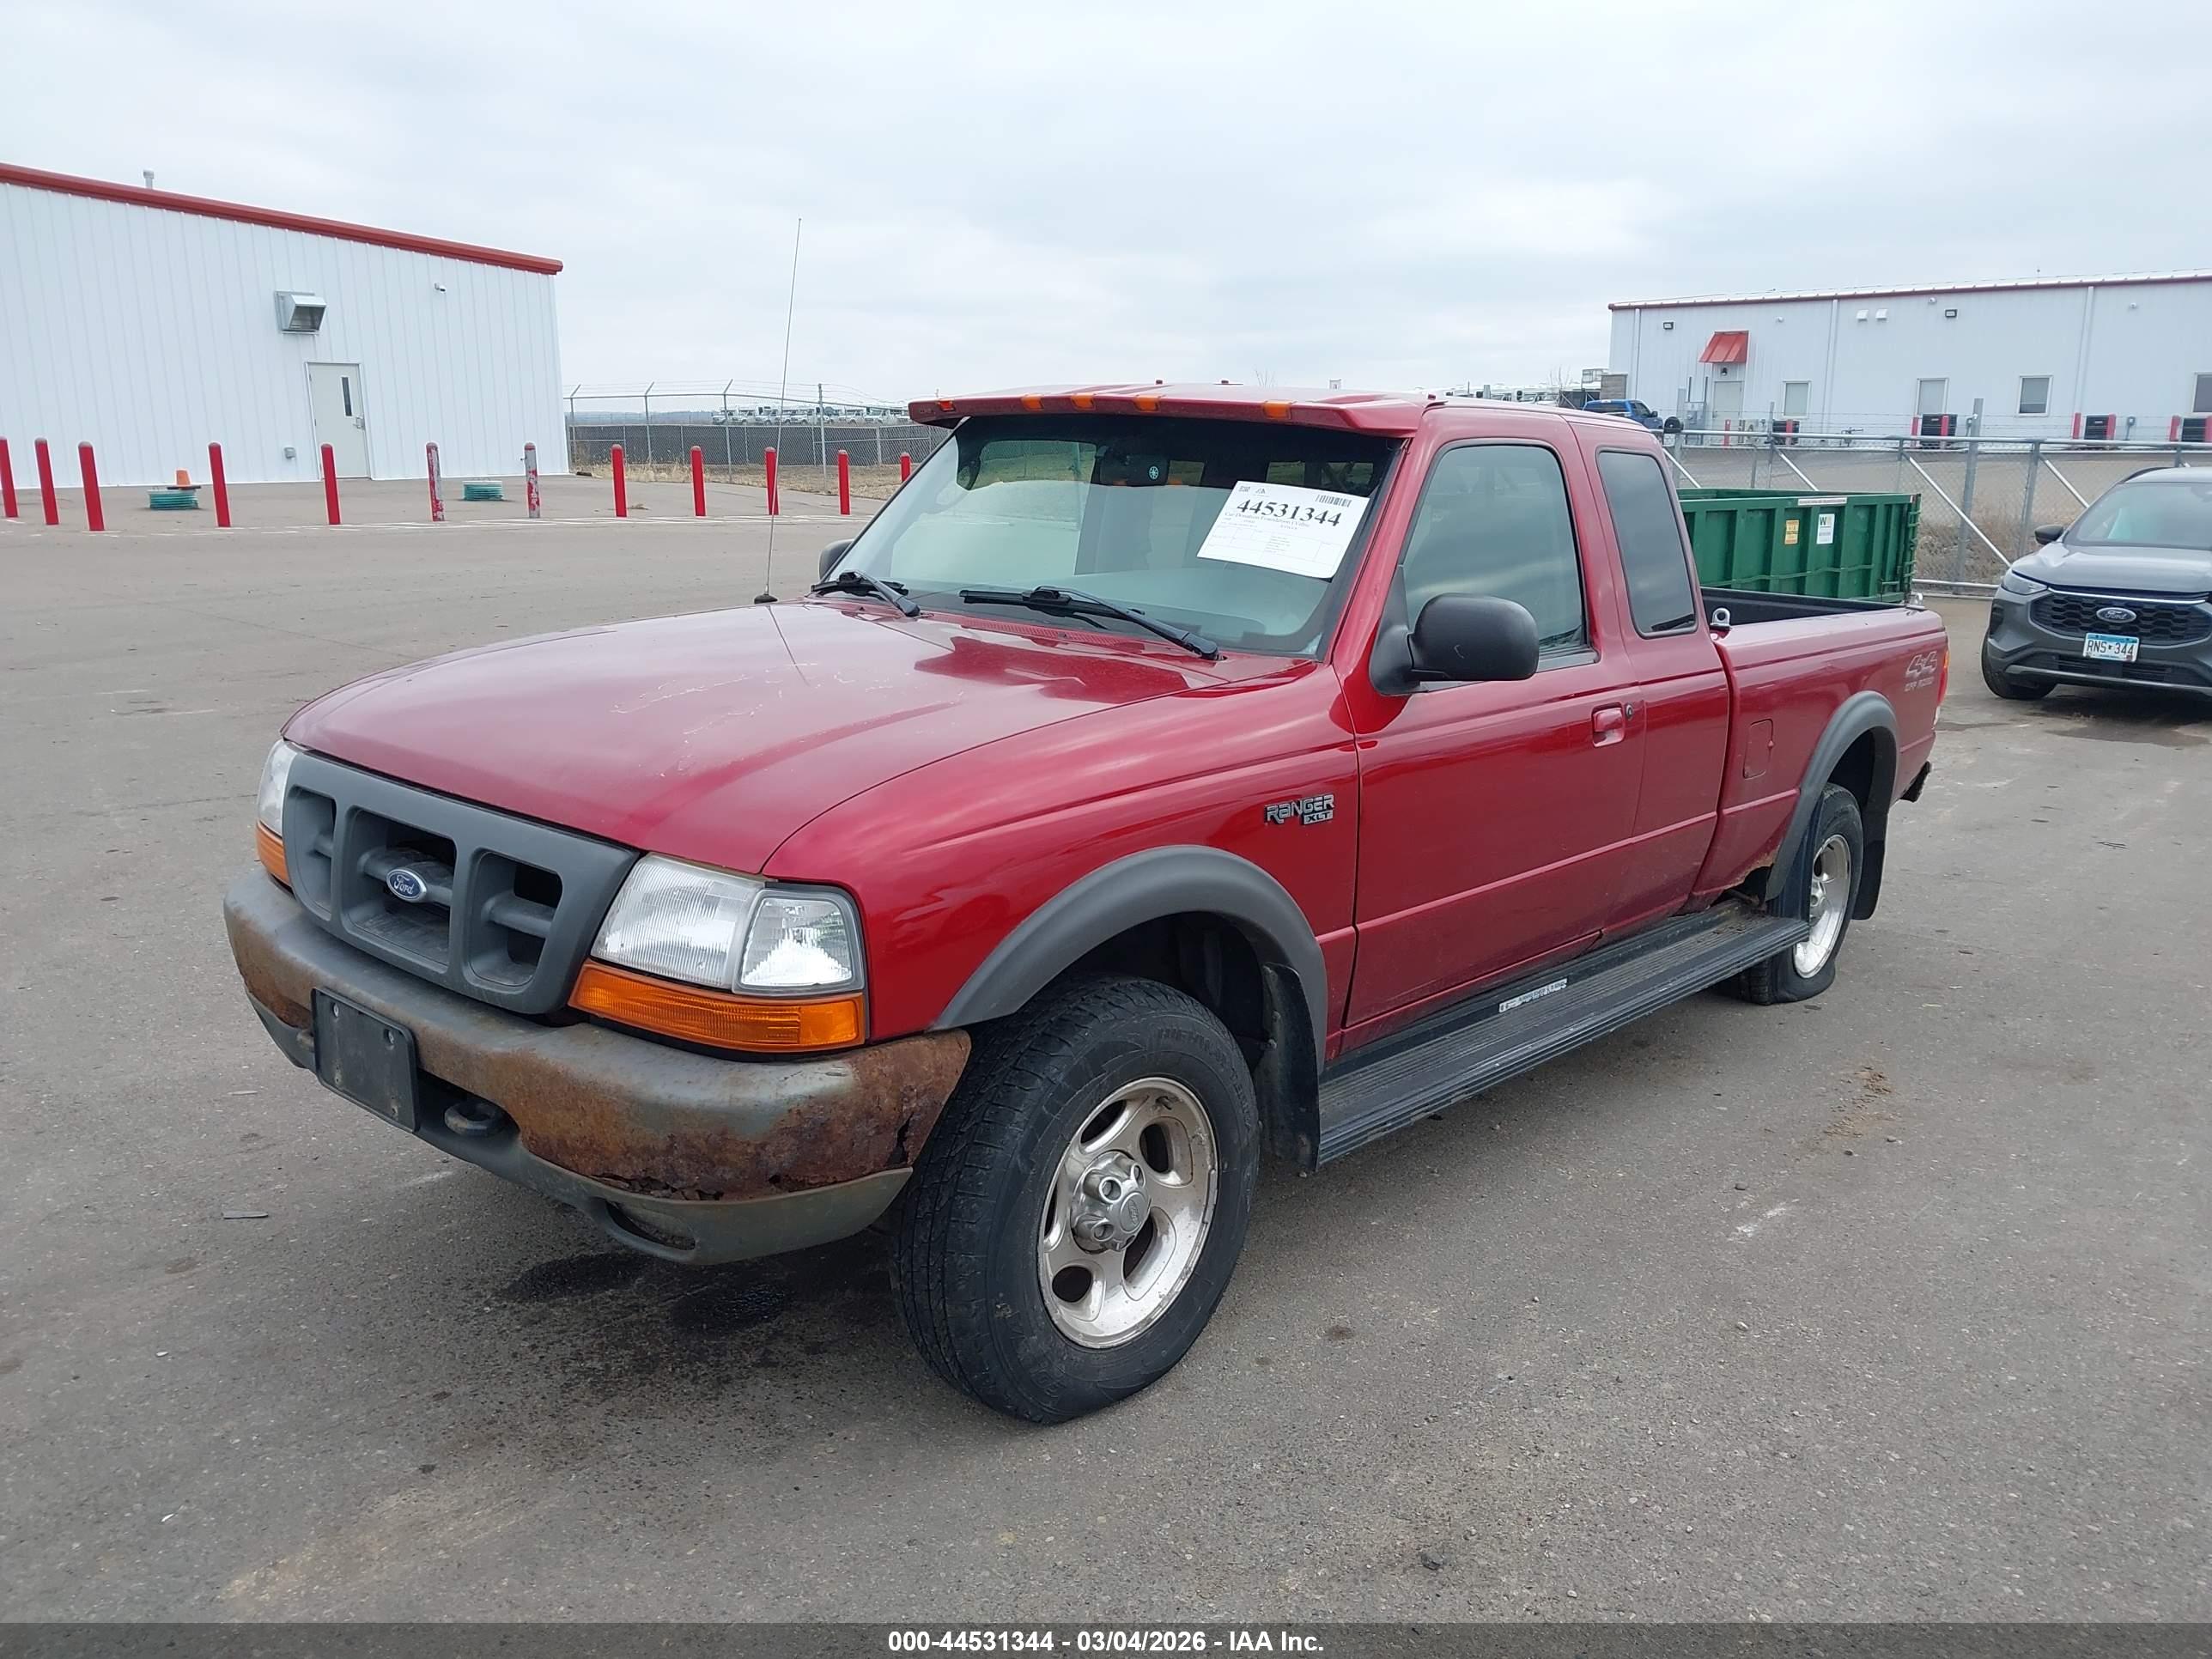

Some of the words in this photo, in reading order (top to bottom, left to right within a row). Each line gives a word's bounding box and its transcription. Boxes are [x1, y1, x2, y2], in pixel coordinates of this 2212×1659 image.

[1237, 499, 1341, 526] 44531344
[2105, 610, 2127, 620] Ford
[2087, 640, 2107, 653] RNS
[2114, 642, 2135, 655] 344
[1266, 793, 1334, 824] RANGER
[1308, 811, 1331, 823] XLT
[393, 874, 415, 895] Ford
